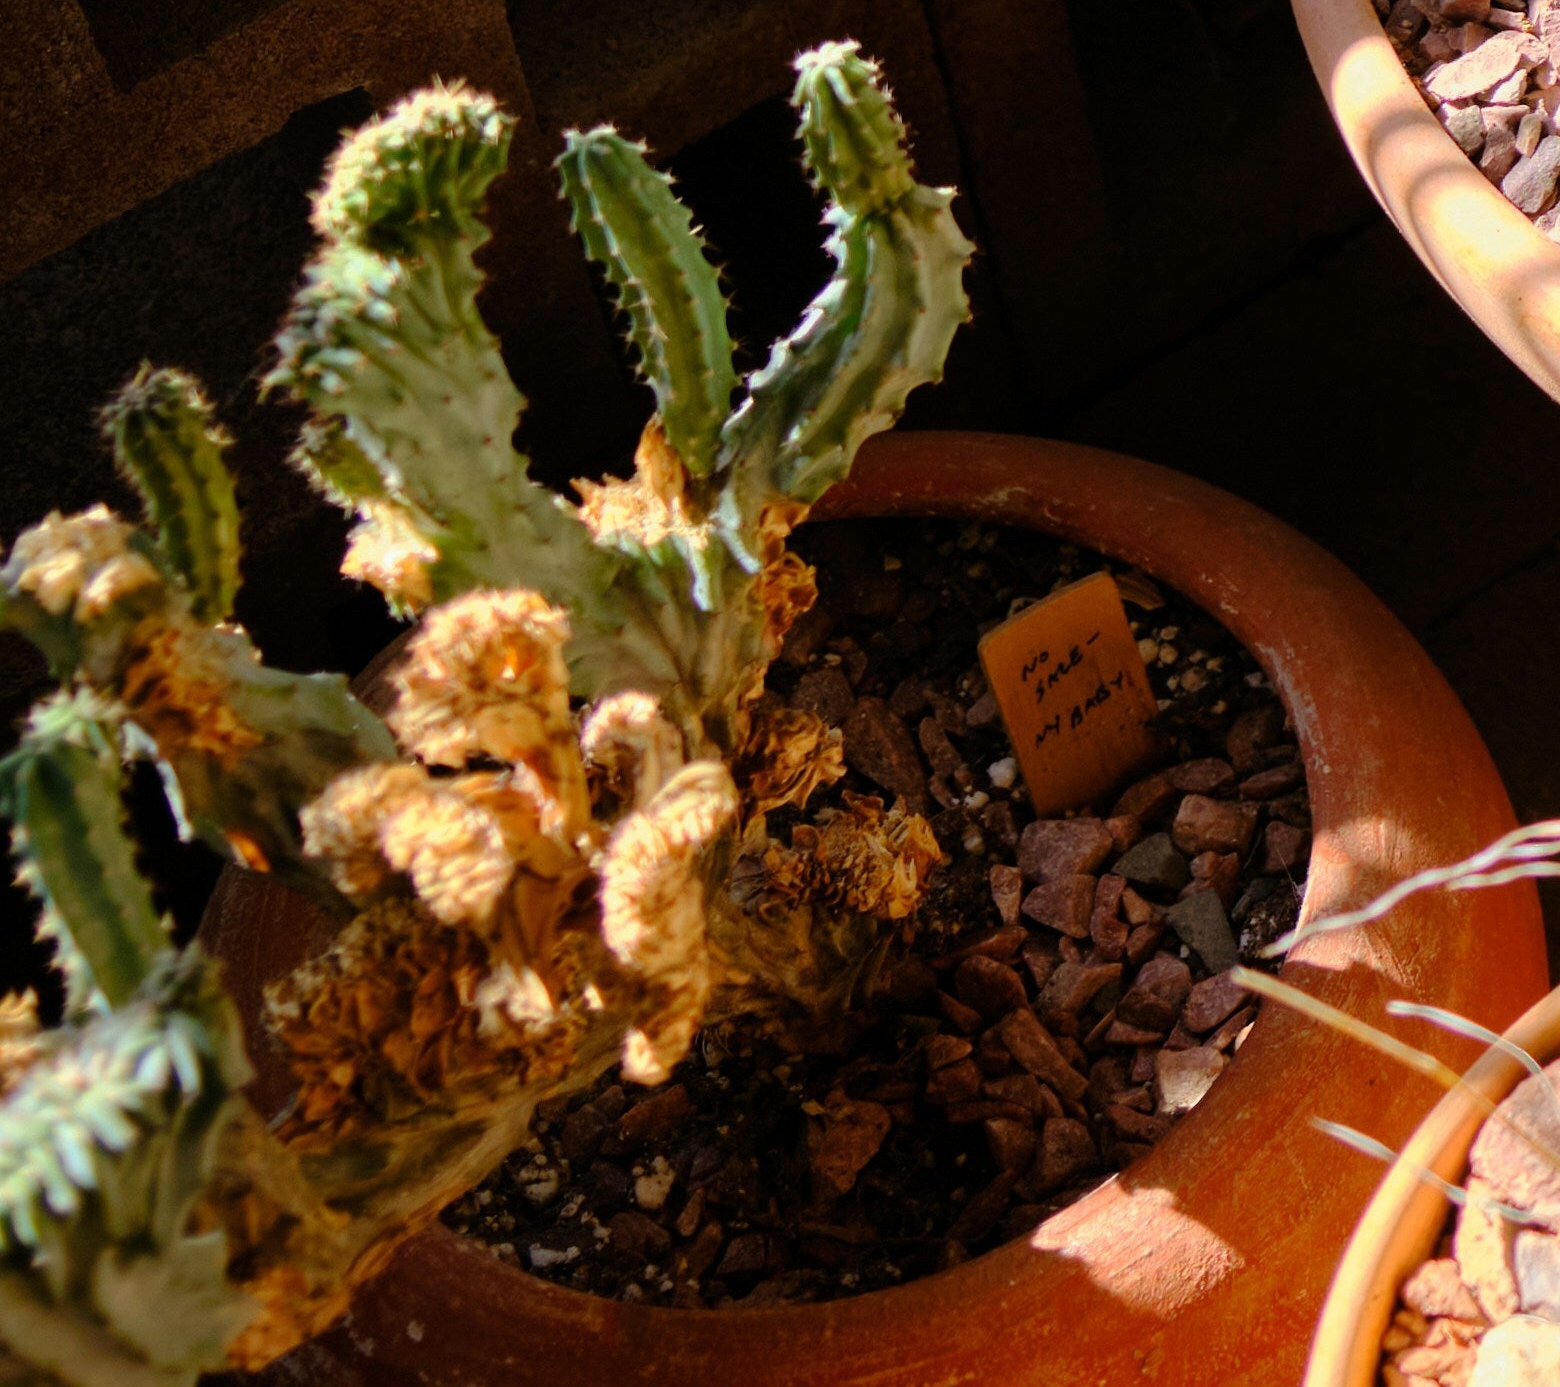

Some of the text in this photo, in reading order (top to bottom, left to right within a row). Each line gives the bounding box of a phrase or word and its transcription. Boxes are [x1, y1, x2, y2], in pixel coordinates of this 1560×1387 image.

[1022, 650, 1049, 682] NO
[1035, 670, 1123, 749] MY BABY
